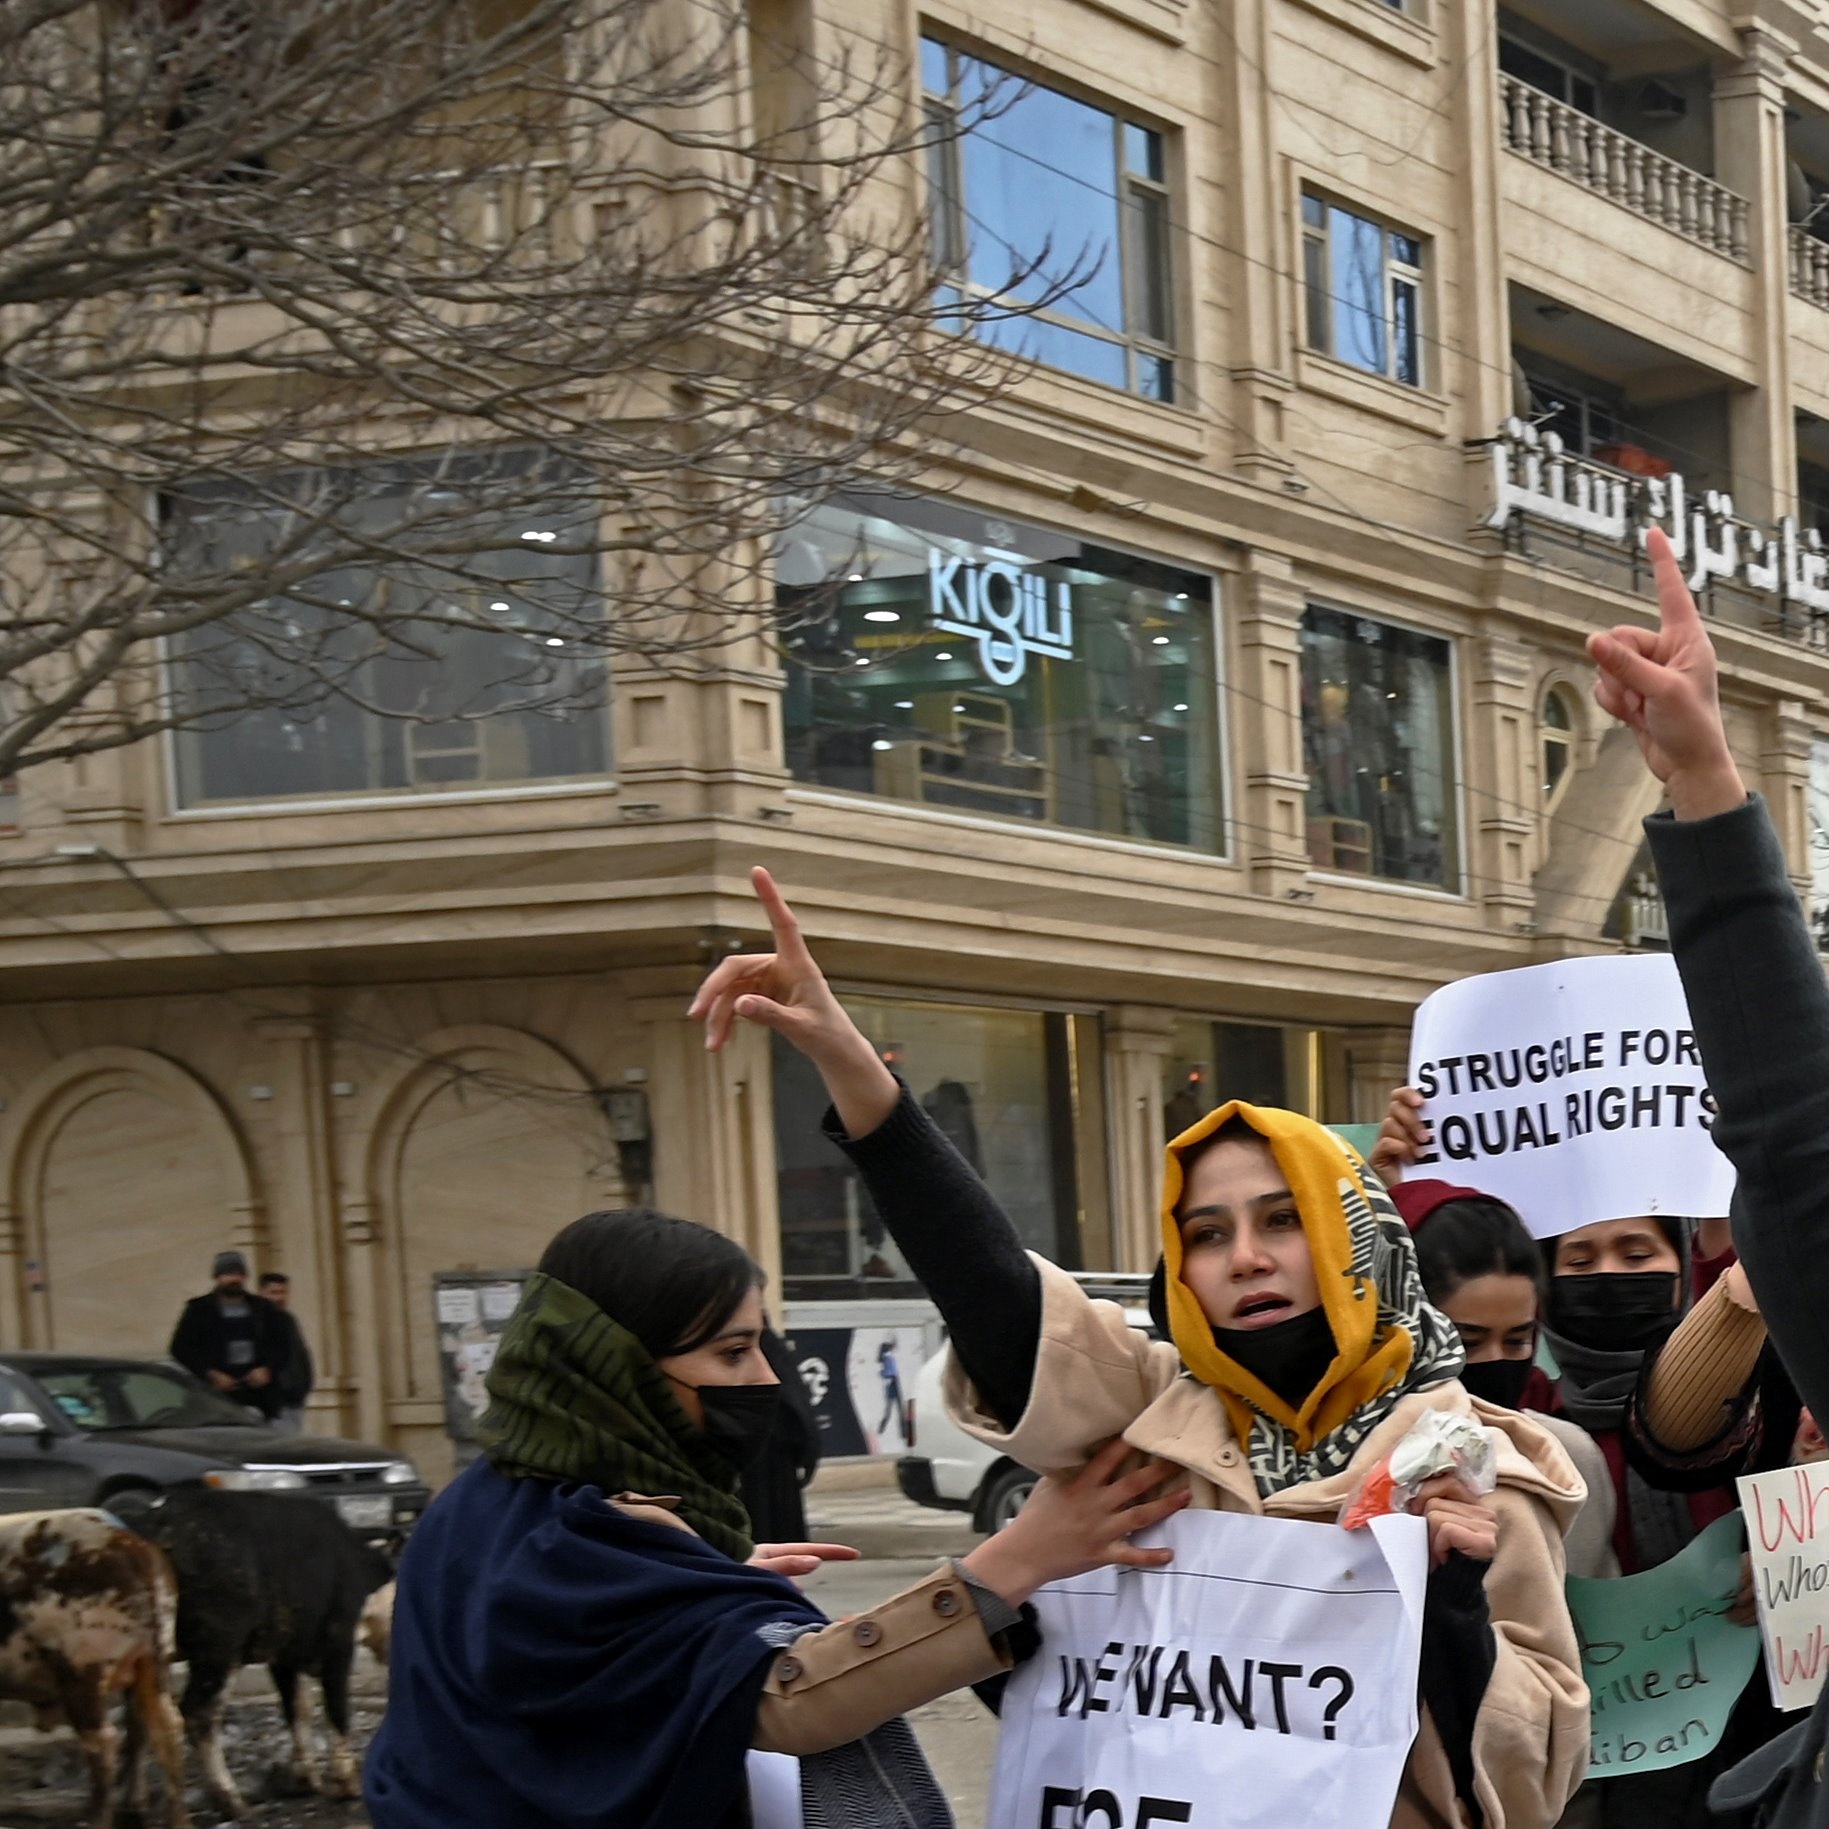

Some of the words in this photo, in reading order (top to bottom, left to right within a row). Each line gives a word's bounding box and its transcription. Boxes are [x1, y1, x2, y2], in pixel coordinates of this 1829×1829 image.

[1417, 1031, 1604, 1099] STRUGGLE
[1619, 1028, 1702, 1067] FOR
[1413, 1102, 1561, 1166] EQUAL
[1564, 1084, 1719, 1140] RIGHTS
